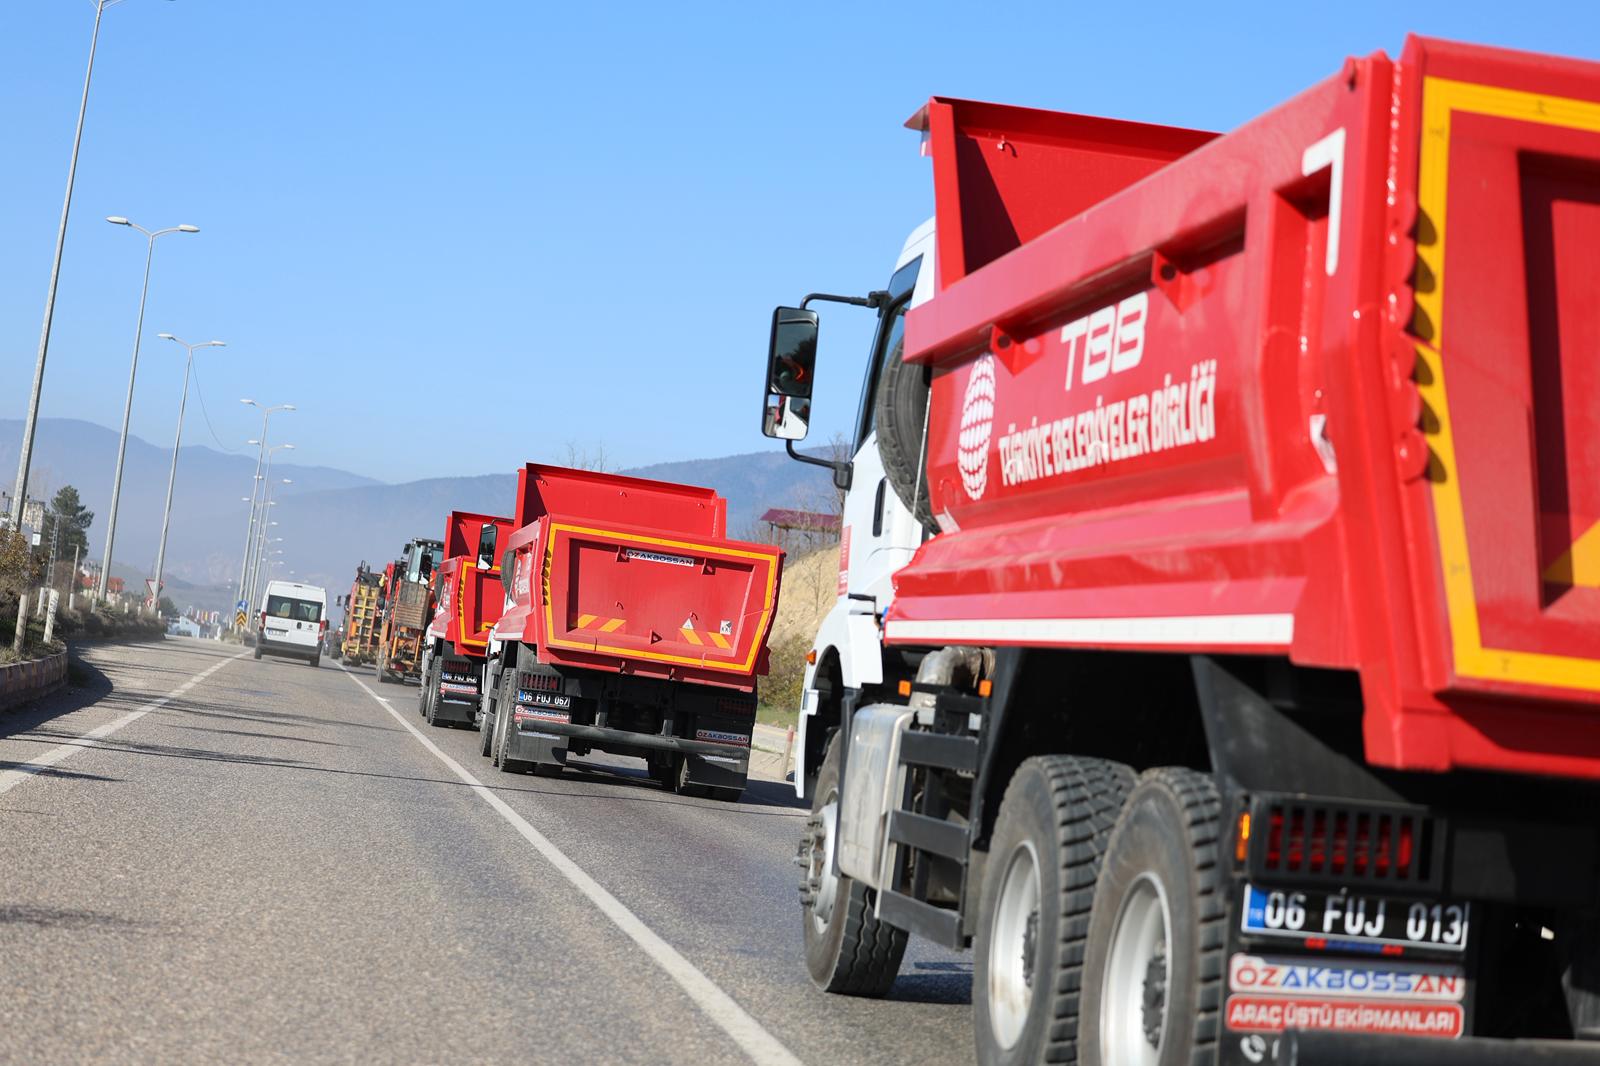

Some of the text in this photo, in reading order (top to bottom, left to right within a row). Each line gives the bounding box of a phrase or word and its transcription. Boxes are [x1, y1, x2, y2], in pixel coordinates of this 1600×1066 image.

[1060, 291, 1148, 392] TBB
[998, 358, 1217, 486] TÜRKİYE BELEDİYELER BİRLİĞİ
[523, 692, 568, 706] 06 FUJ 067
[1264, 890, 1462, 944] 06 FUJ 013
[1230, 1002, 1455, 1031] ARAÇ ÜSTÜ EKİPMANLARI
